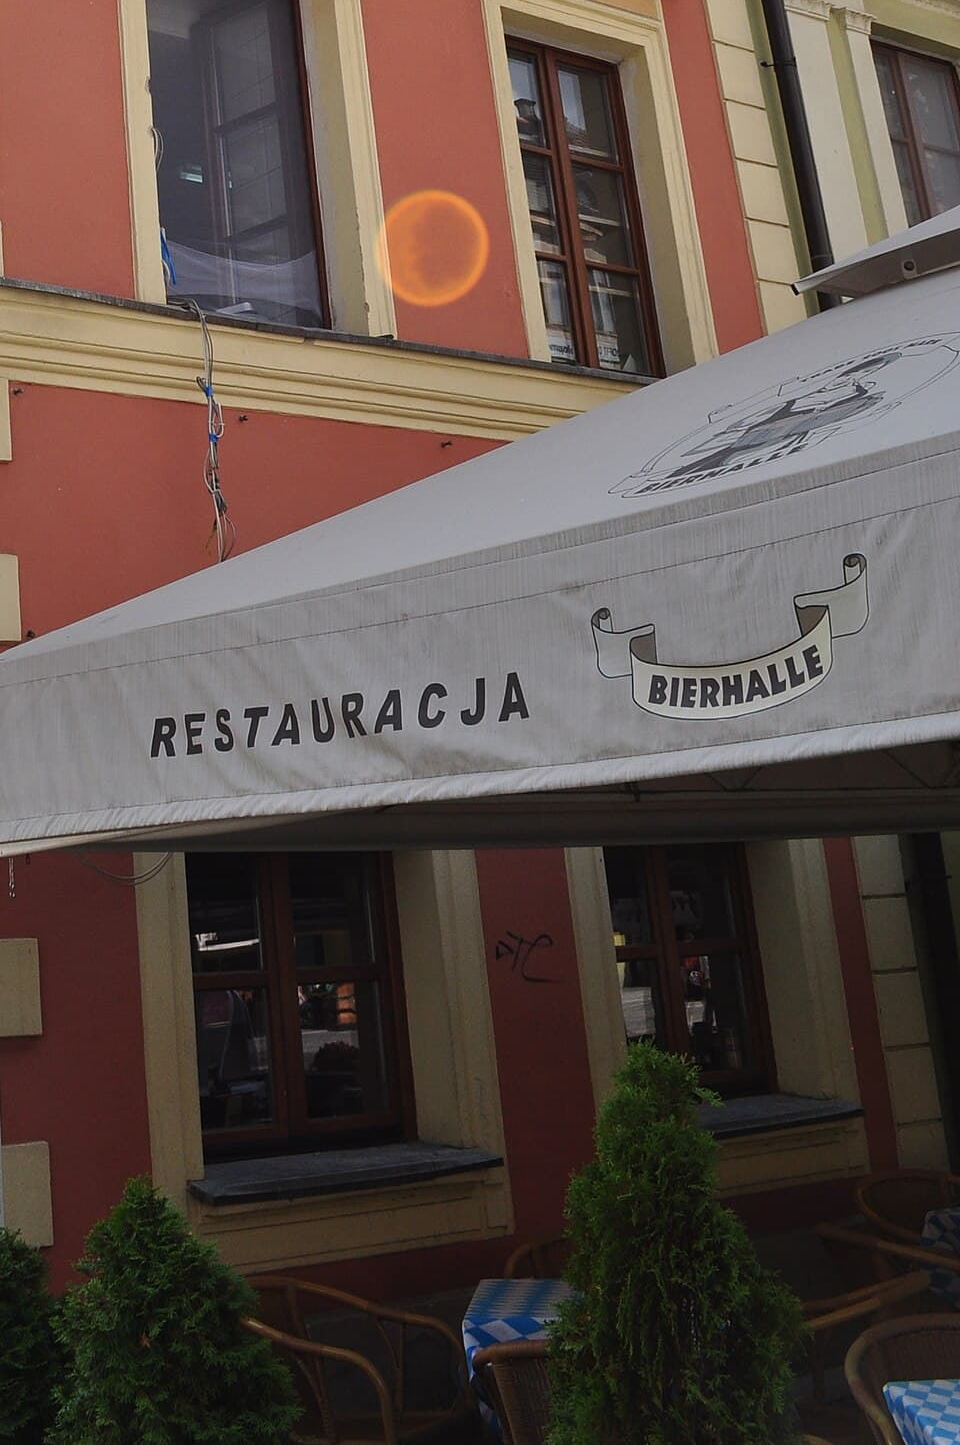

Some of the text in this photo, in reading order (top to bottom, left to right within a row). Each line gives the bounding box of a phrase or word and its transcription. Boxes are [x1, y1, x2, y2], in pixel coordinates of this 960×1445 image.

[636, 442, 809, 495] BIERHALLE
[647, 644, 823, 709] BIERHALLE
[150, 672, 530, 758] RESTAURACJA
